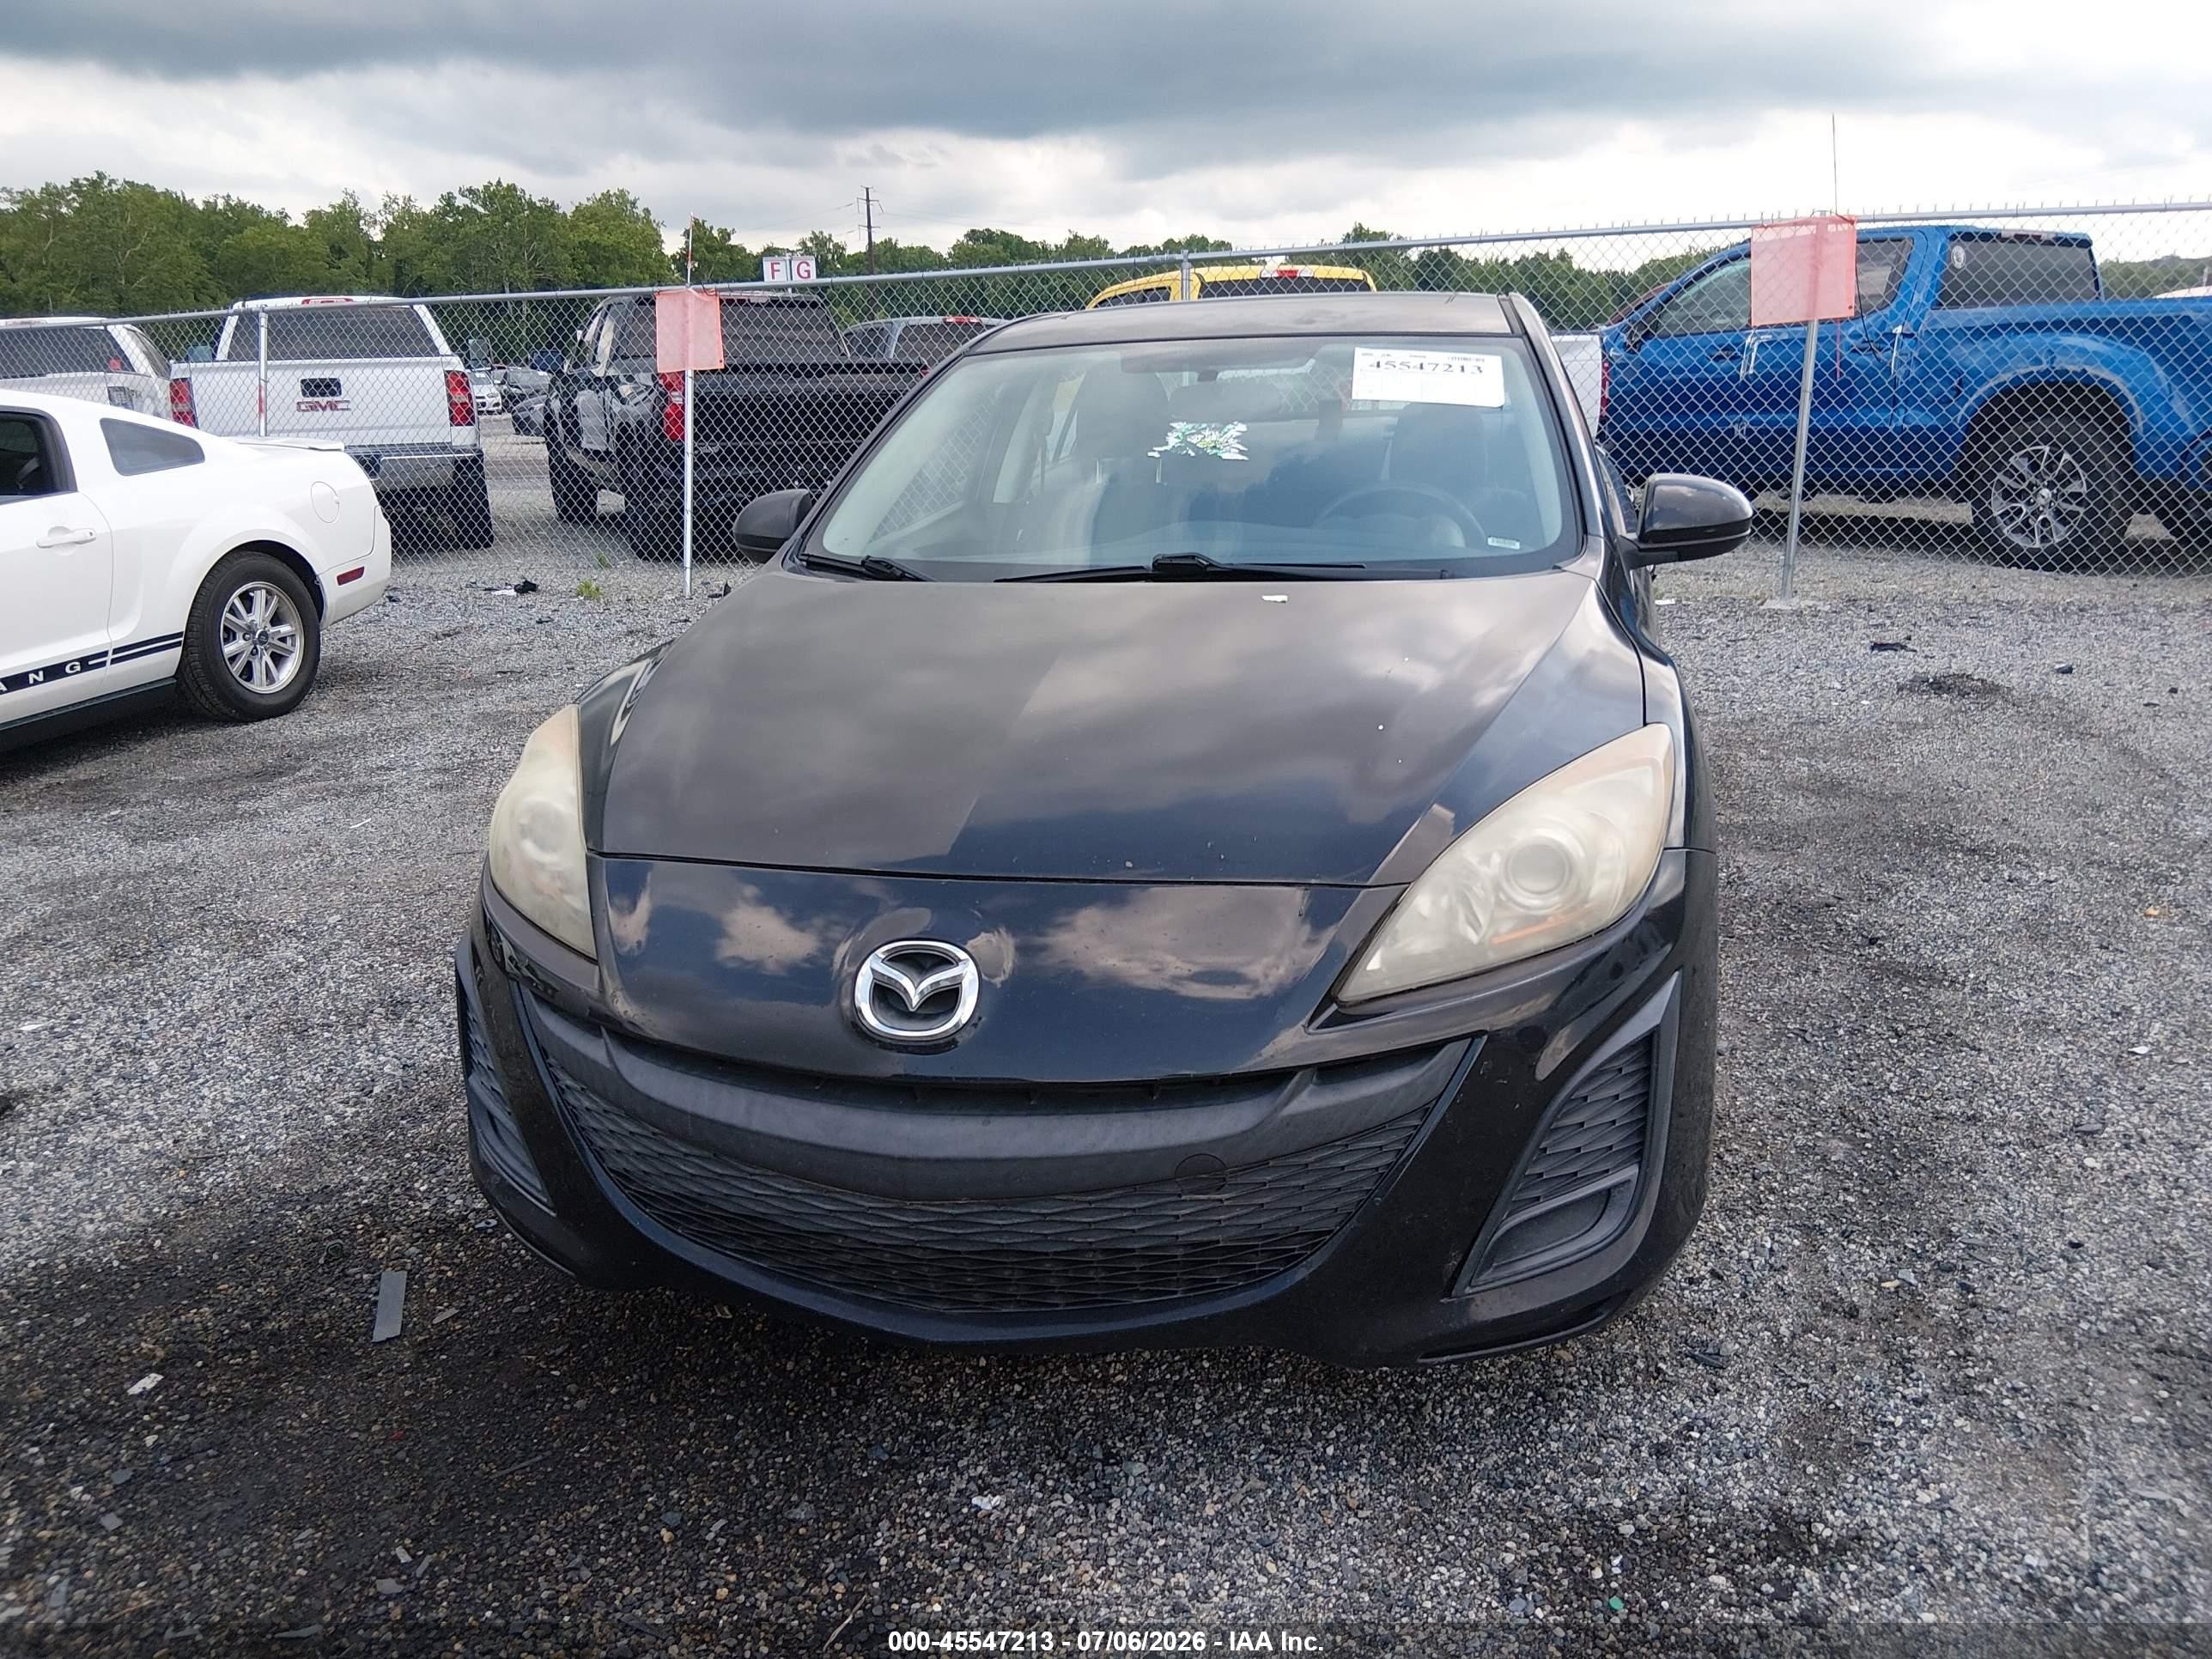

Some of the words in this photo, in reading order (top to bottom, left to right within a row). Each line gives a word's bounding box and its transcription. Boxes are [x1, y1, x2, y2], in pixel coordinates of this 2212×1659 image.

[769, 261, 781, 280] F
[796, 261, 811, 279] G
[1368, 360, 1484, 374] 45547213
[296, 399, 351, 413] GMC
